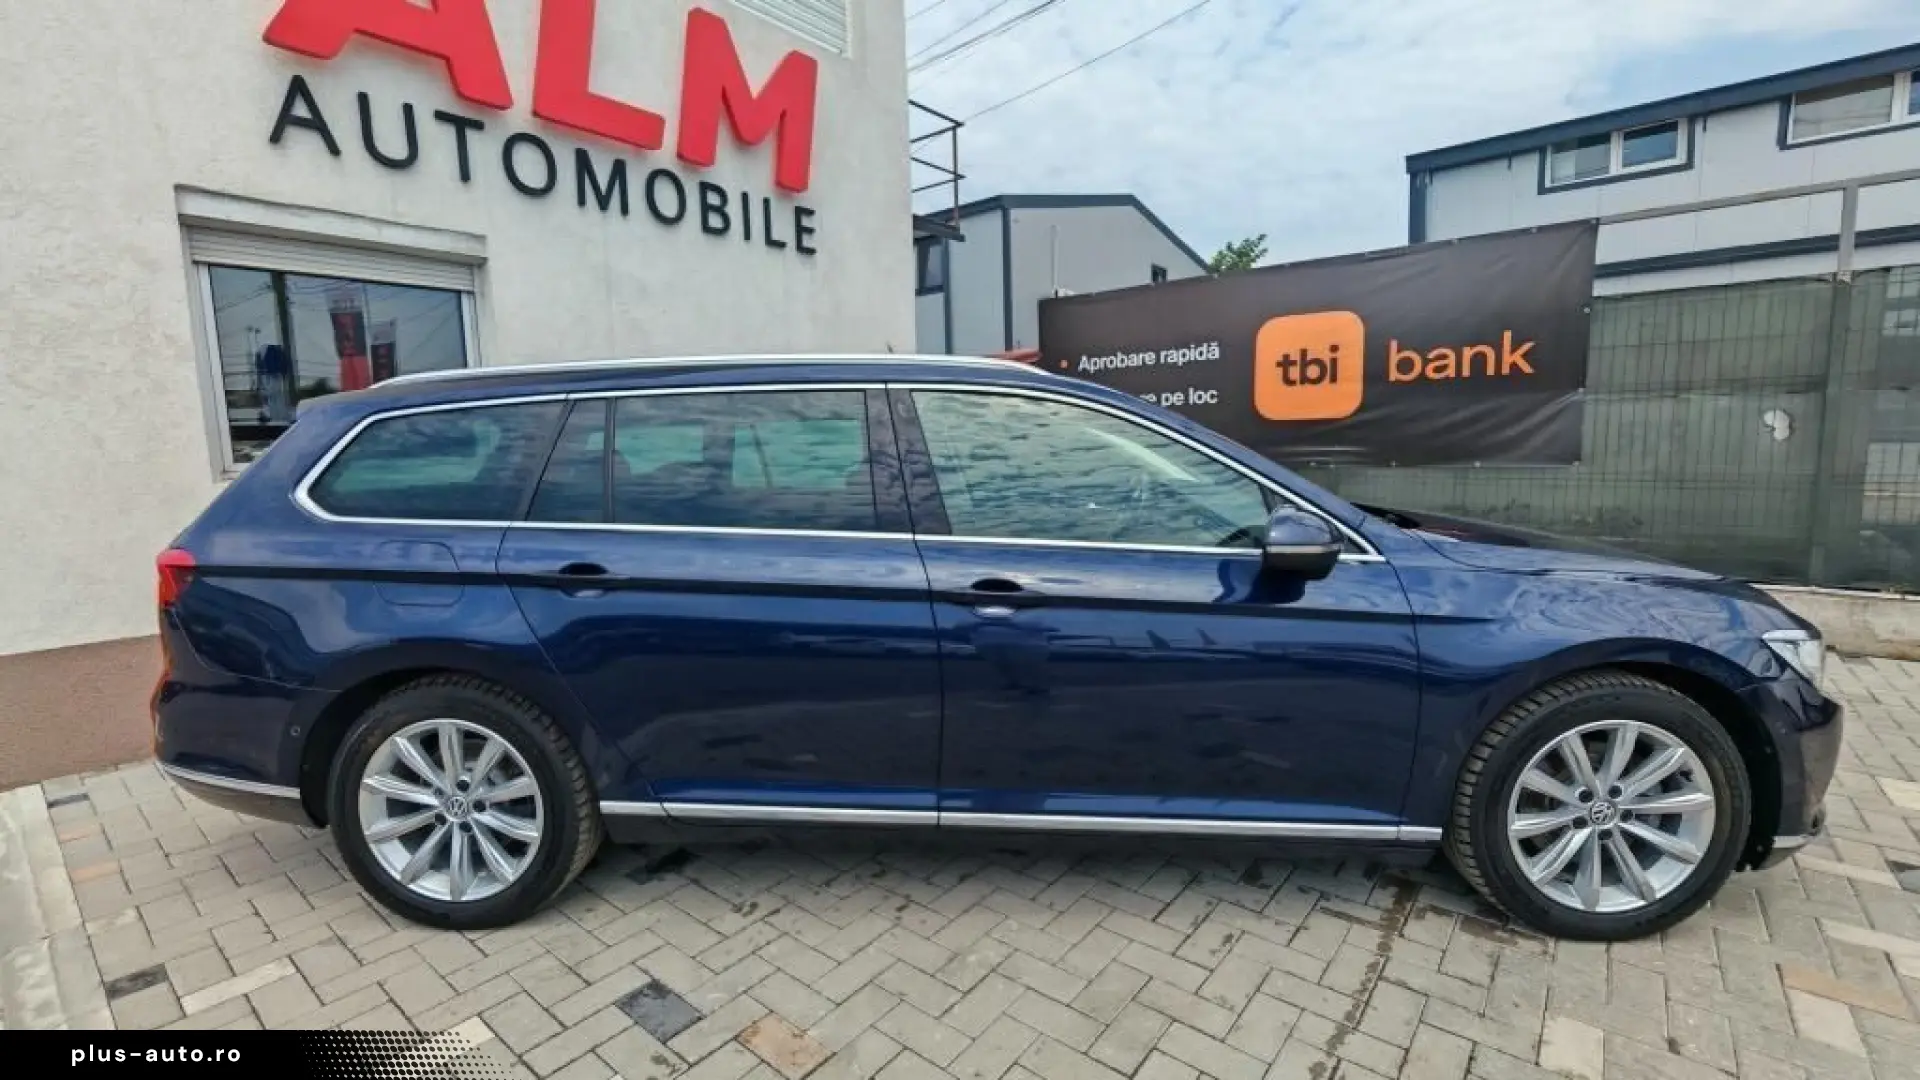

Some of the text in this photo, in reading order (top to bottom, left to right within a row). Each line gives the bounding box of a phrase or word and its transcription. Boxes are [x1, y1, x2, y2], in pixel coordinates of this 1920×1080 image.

[269, 75, 817, 256] AUTOMOBILE
[1077, 341, 1220, 374] Aprobare rapidă
[1276, 329, 1536, 387] tbi bank
[1160, 391, 1185, 407] pe
[1188, 386, 1219, 405] loc
